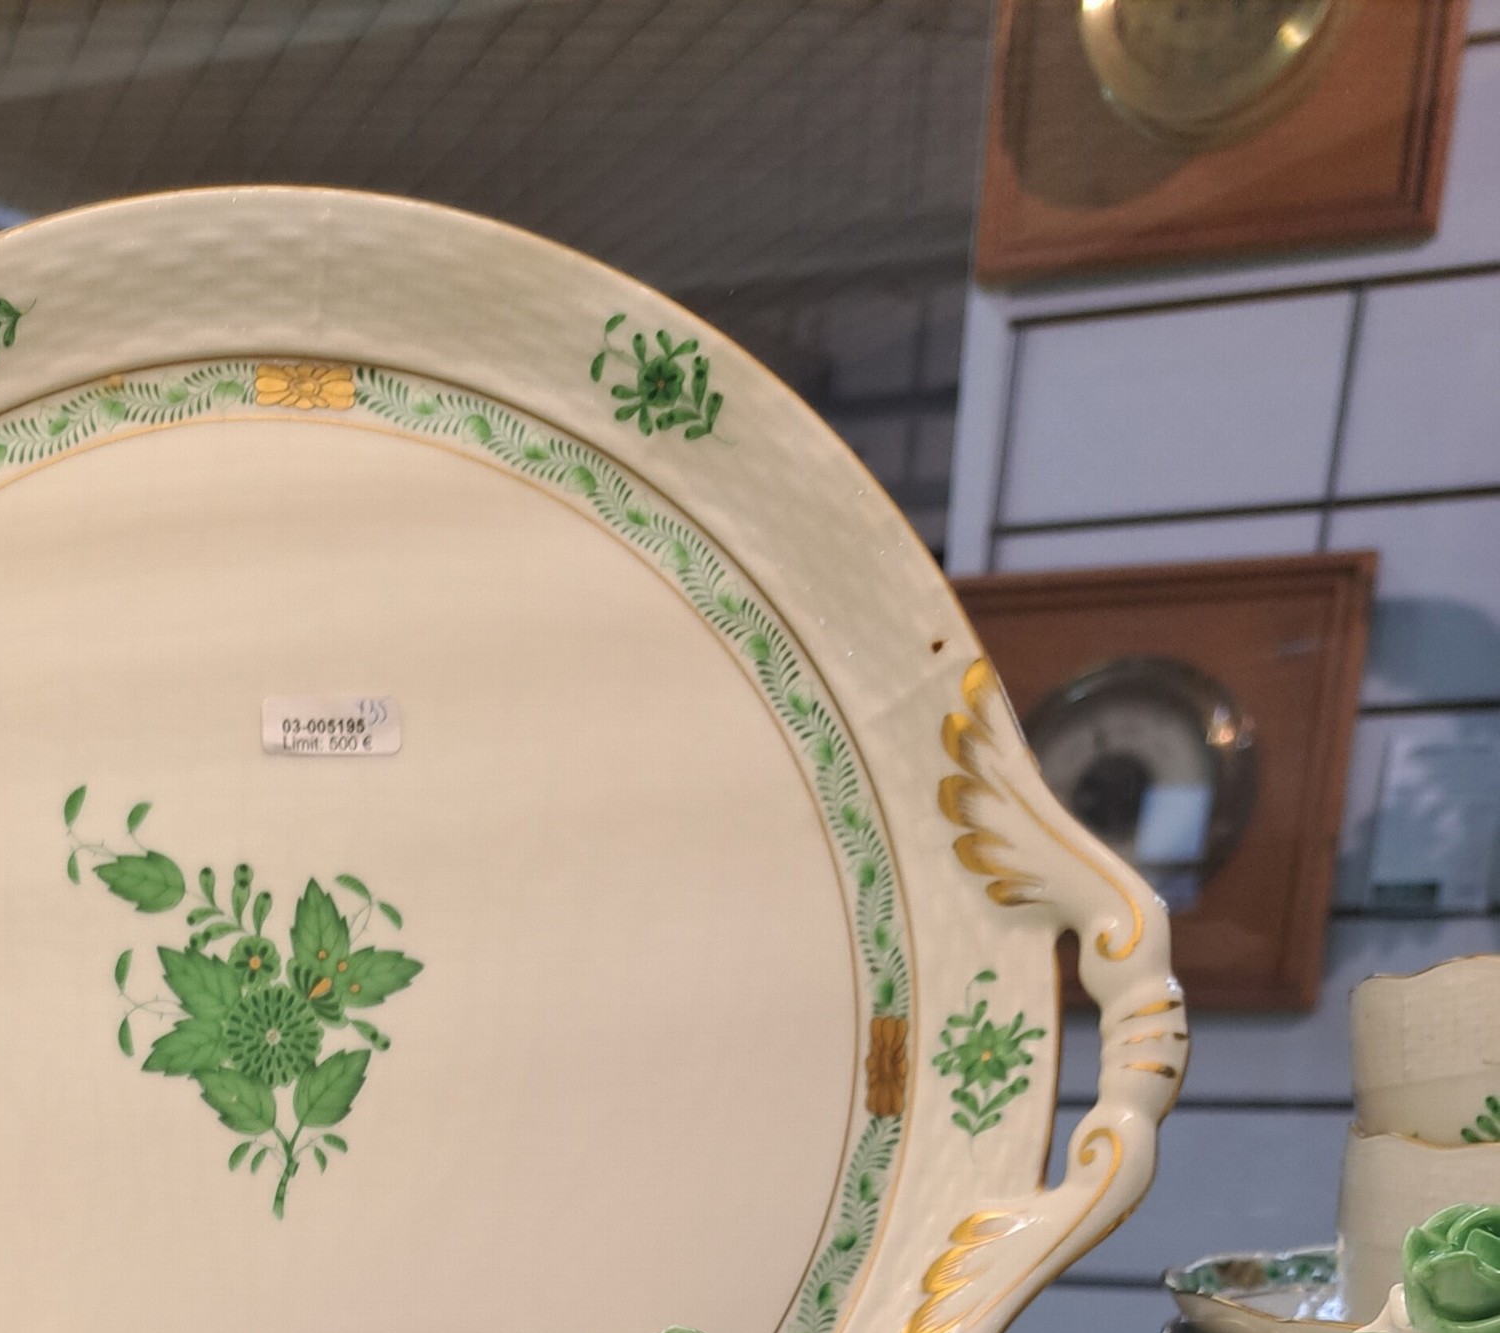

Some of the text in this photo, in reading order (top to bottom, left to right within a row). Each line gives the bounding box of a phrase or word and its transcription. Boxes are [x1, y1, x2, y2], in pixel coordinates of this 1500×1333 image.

[282, 718, 365, 734] 03-005195
[283, 735, 372, 751] Limit: 500 €
